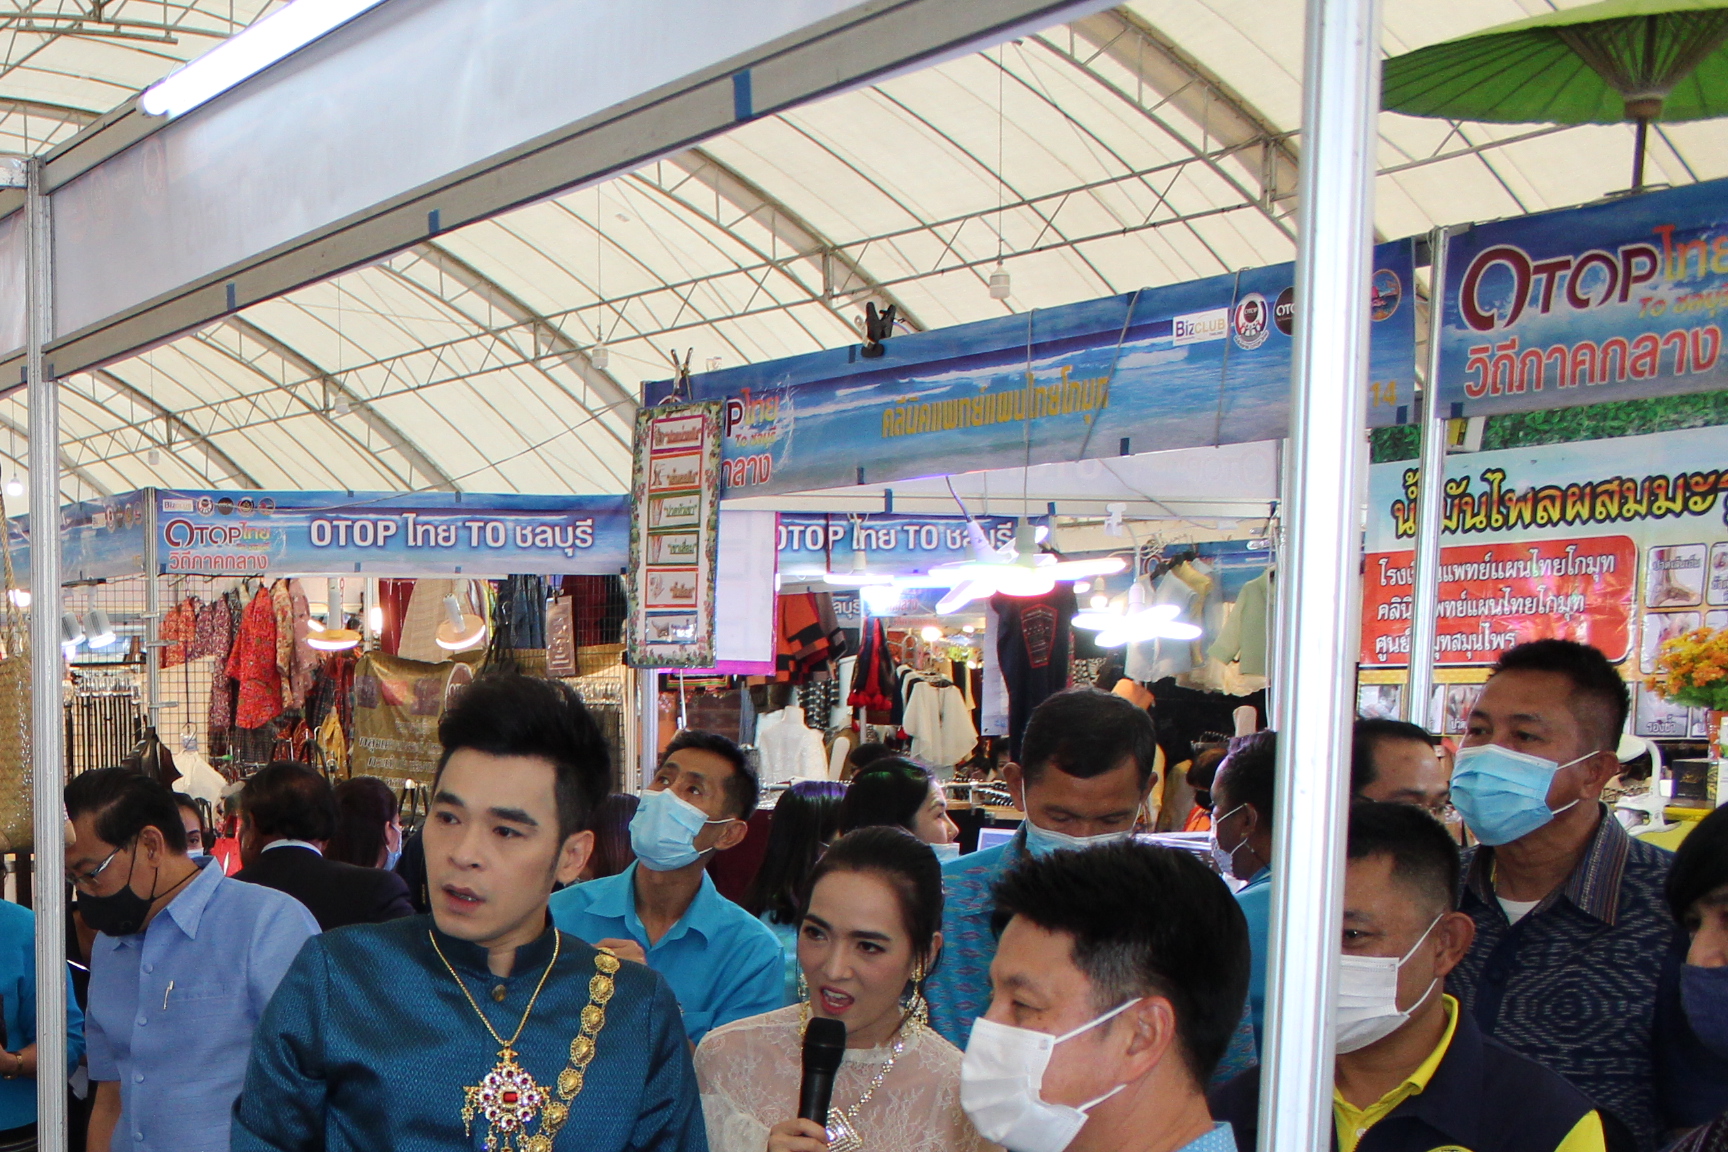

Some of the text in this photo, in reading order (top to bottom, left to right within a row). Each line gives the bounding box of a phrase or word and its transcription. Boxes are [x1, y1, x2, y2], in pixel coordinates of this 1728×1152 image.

[1459, 243, 1661, 333] OTOP
[1464, 325, 1721, 399] วิถีภาคกลาง
[164, 517, 242, 548] OTOP
[310, 513, 593, 557] OTOP ไทย TO ชลบุรี
[903, 525, 938, 550] TO
[170, 551, 268, 569] วิถีภาคกลาง
